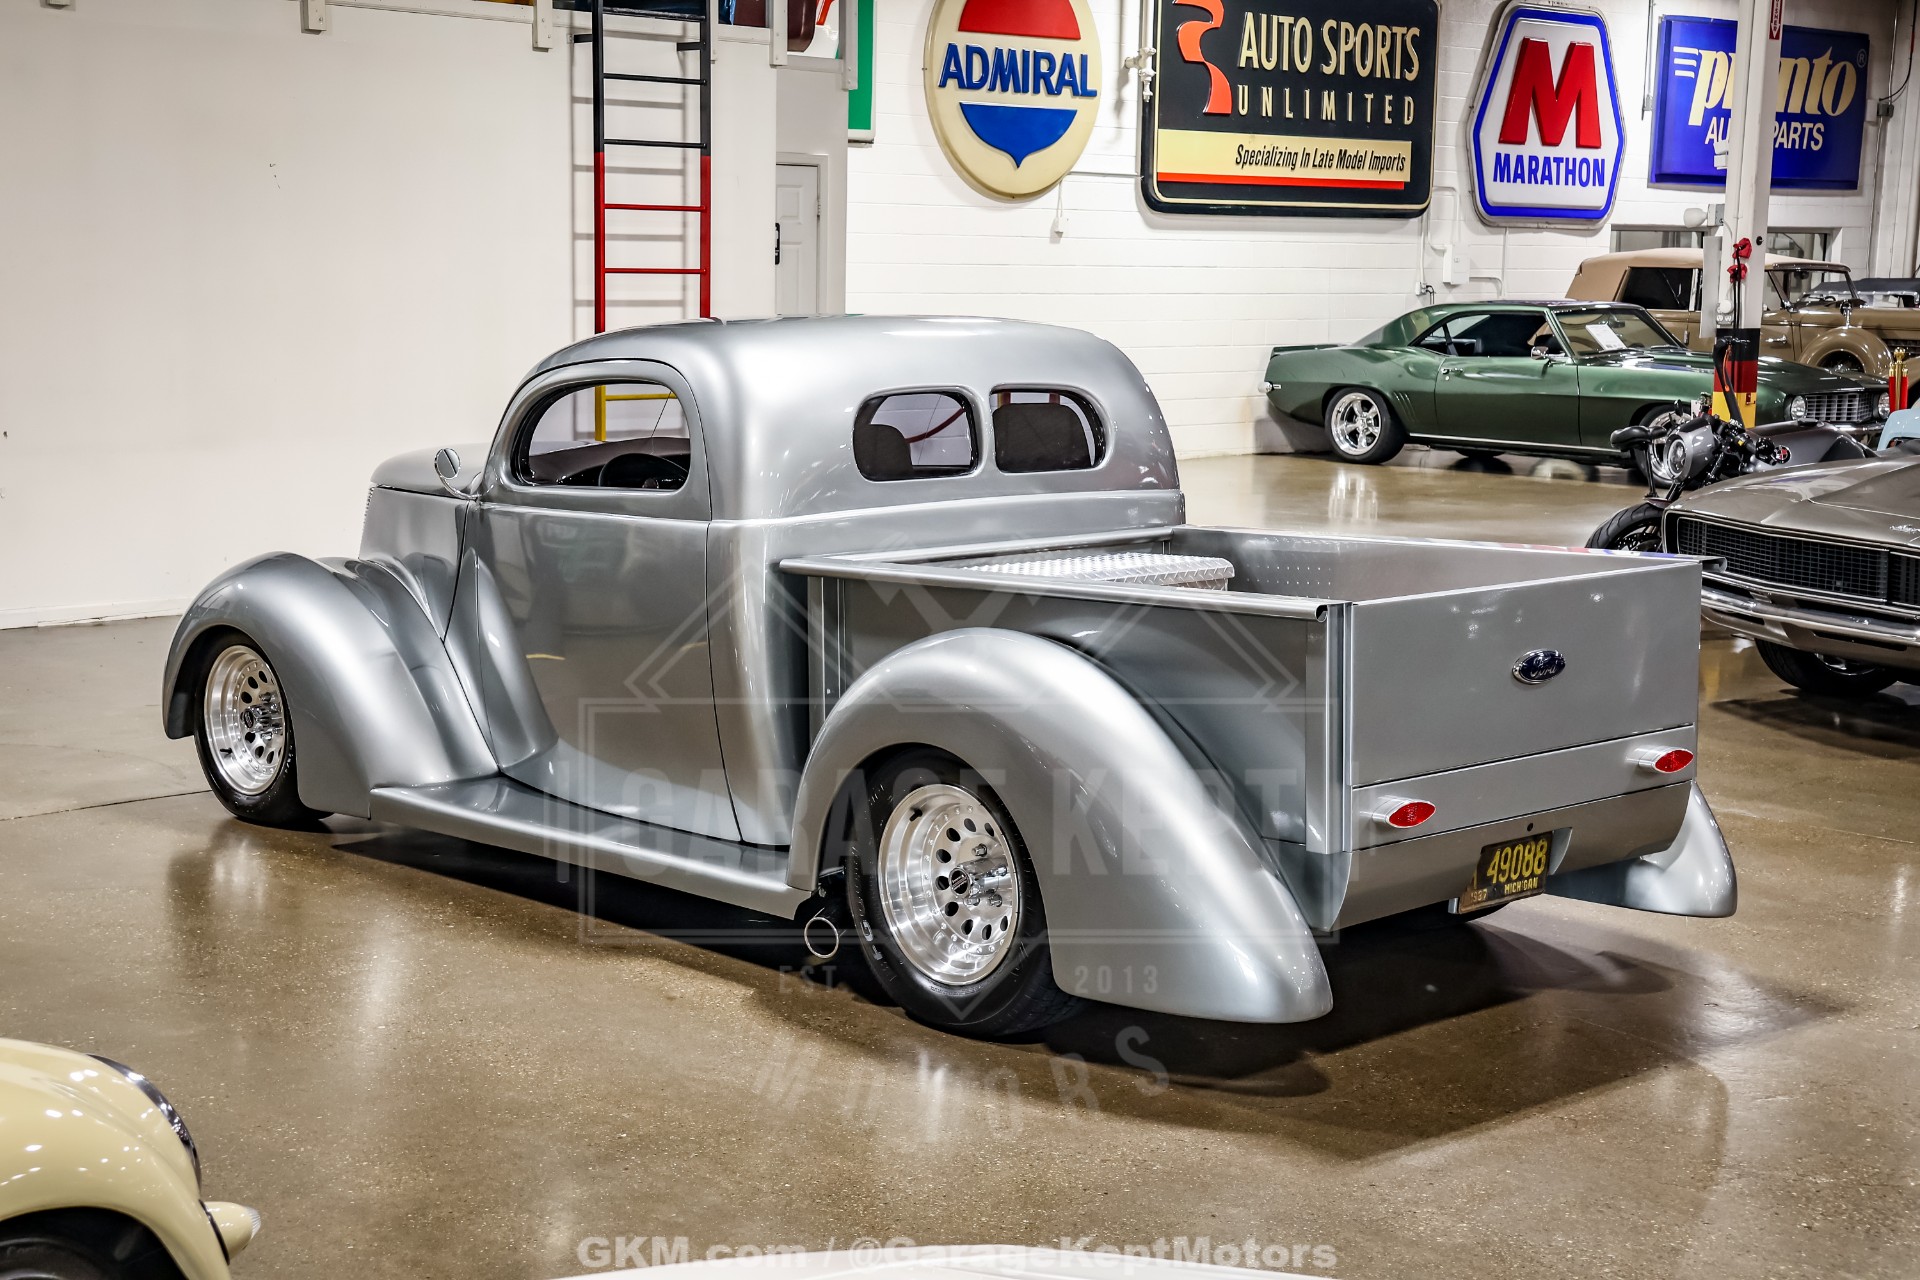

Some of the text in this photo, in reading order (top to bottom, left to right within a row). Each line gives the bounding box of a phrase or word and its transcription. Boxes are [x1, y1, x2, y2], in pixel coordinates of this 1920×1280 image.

[1238, 12, 1420, 81] AUTO SPORTS
[938, 42, 1097, 98] ADMIRAL
[1238, 84, 1415, 125] UNLIMITED
[1498, 36, 1602, 149] M
[1236, 144, 1406, 173] Specializing In Late Model Imports
[1493, 152, 1605, 187] MARATHON
[1531, 656, 1557, 678] Ford
[1504, 877, 1539, 894] MICHIGAN
